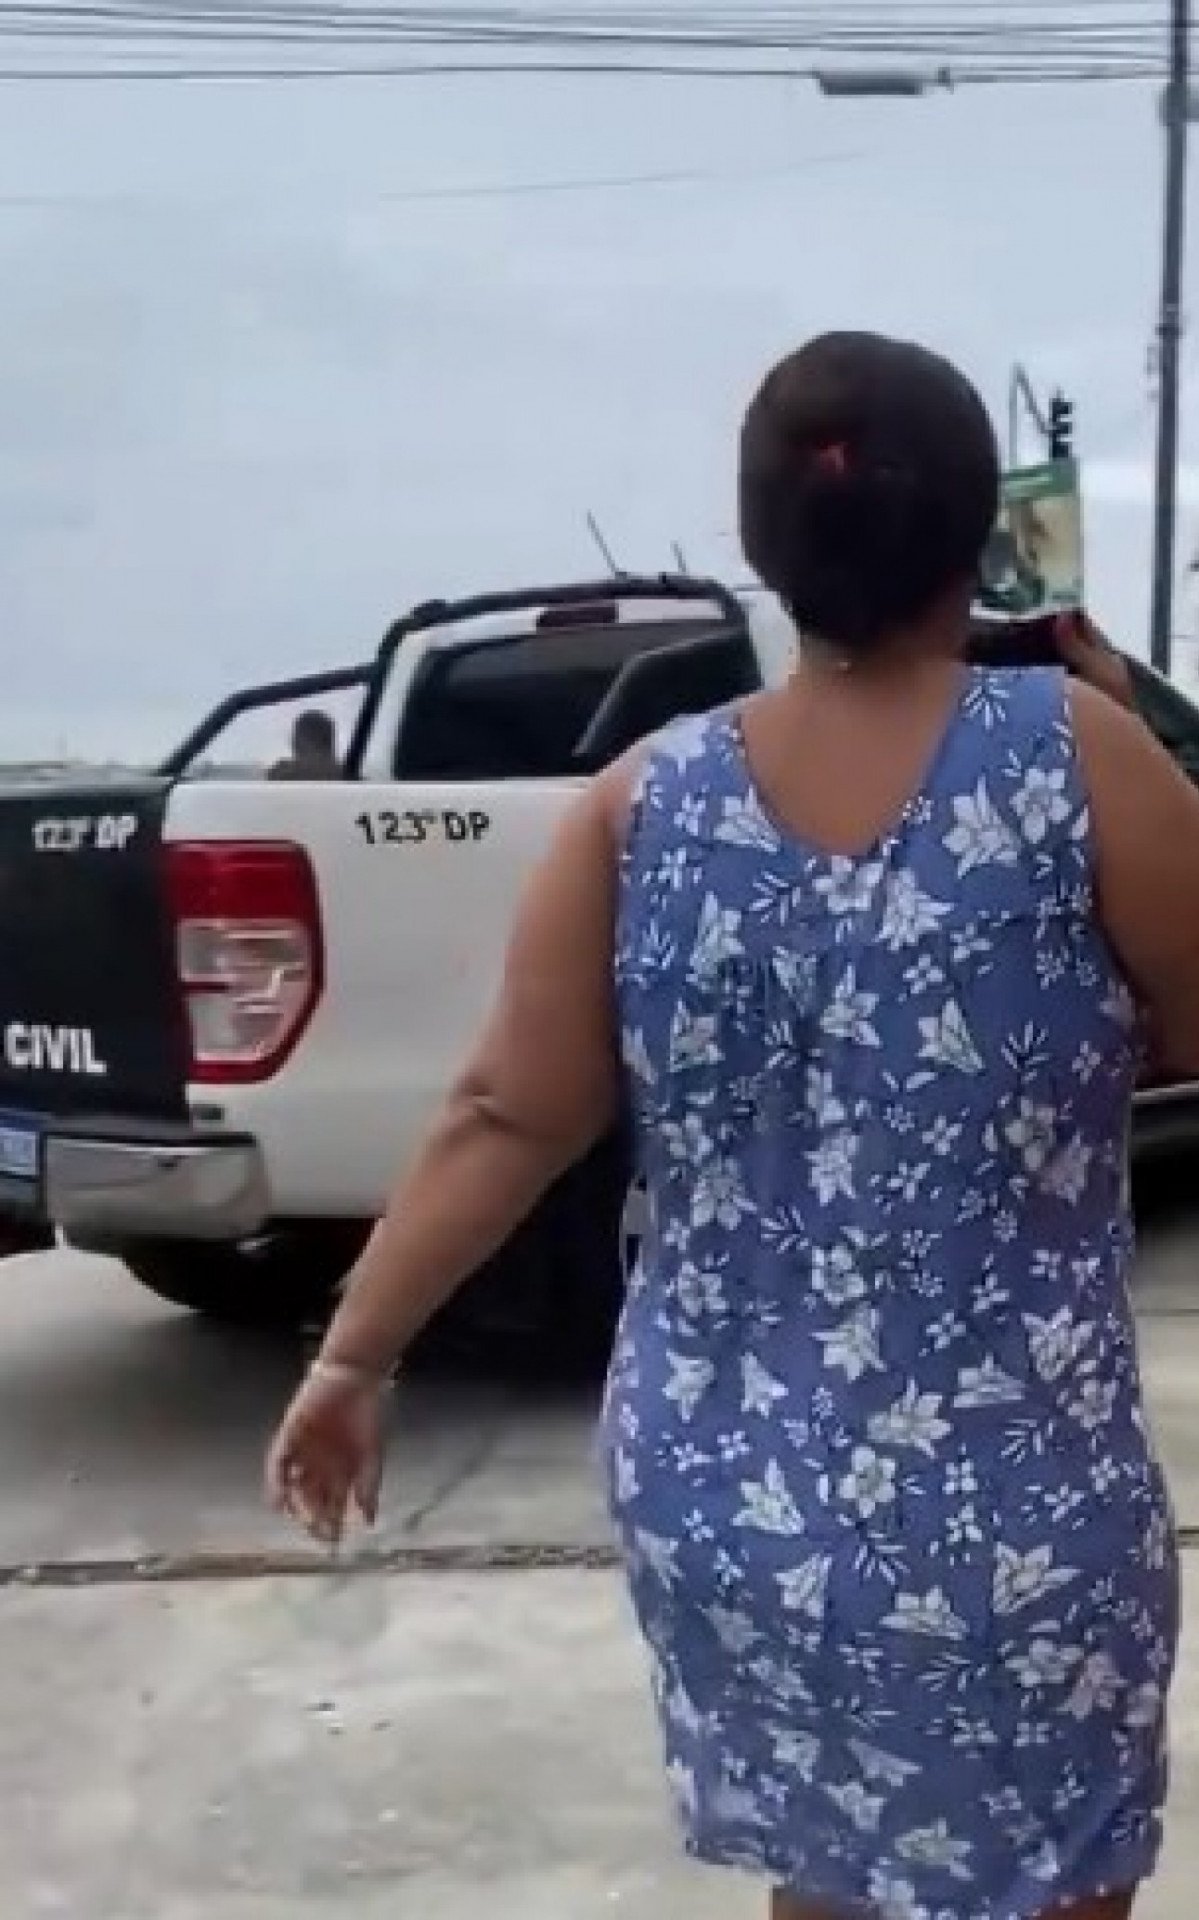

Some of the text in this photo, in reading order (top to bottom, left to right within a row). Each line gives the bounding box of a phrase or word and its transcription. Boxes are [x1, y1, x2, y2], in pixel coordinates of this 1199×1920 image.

[95, 813, 138, 850] DP
[441, 811, 491, 842] DP
[5, 1022, 107, 1075] CIVIL
